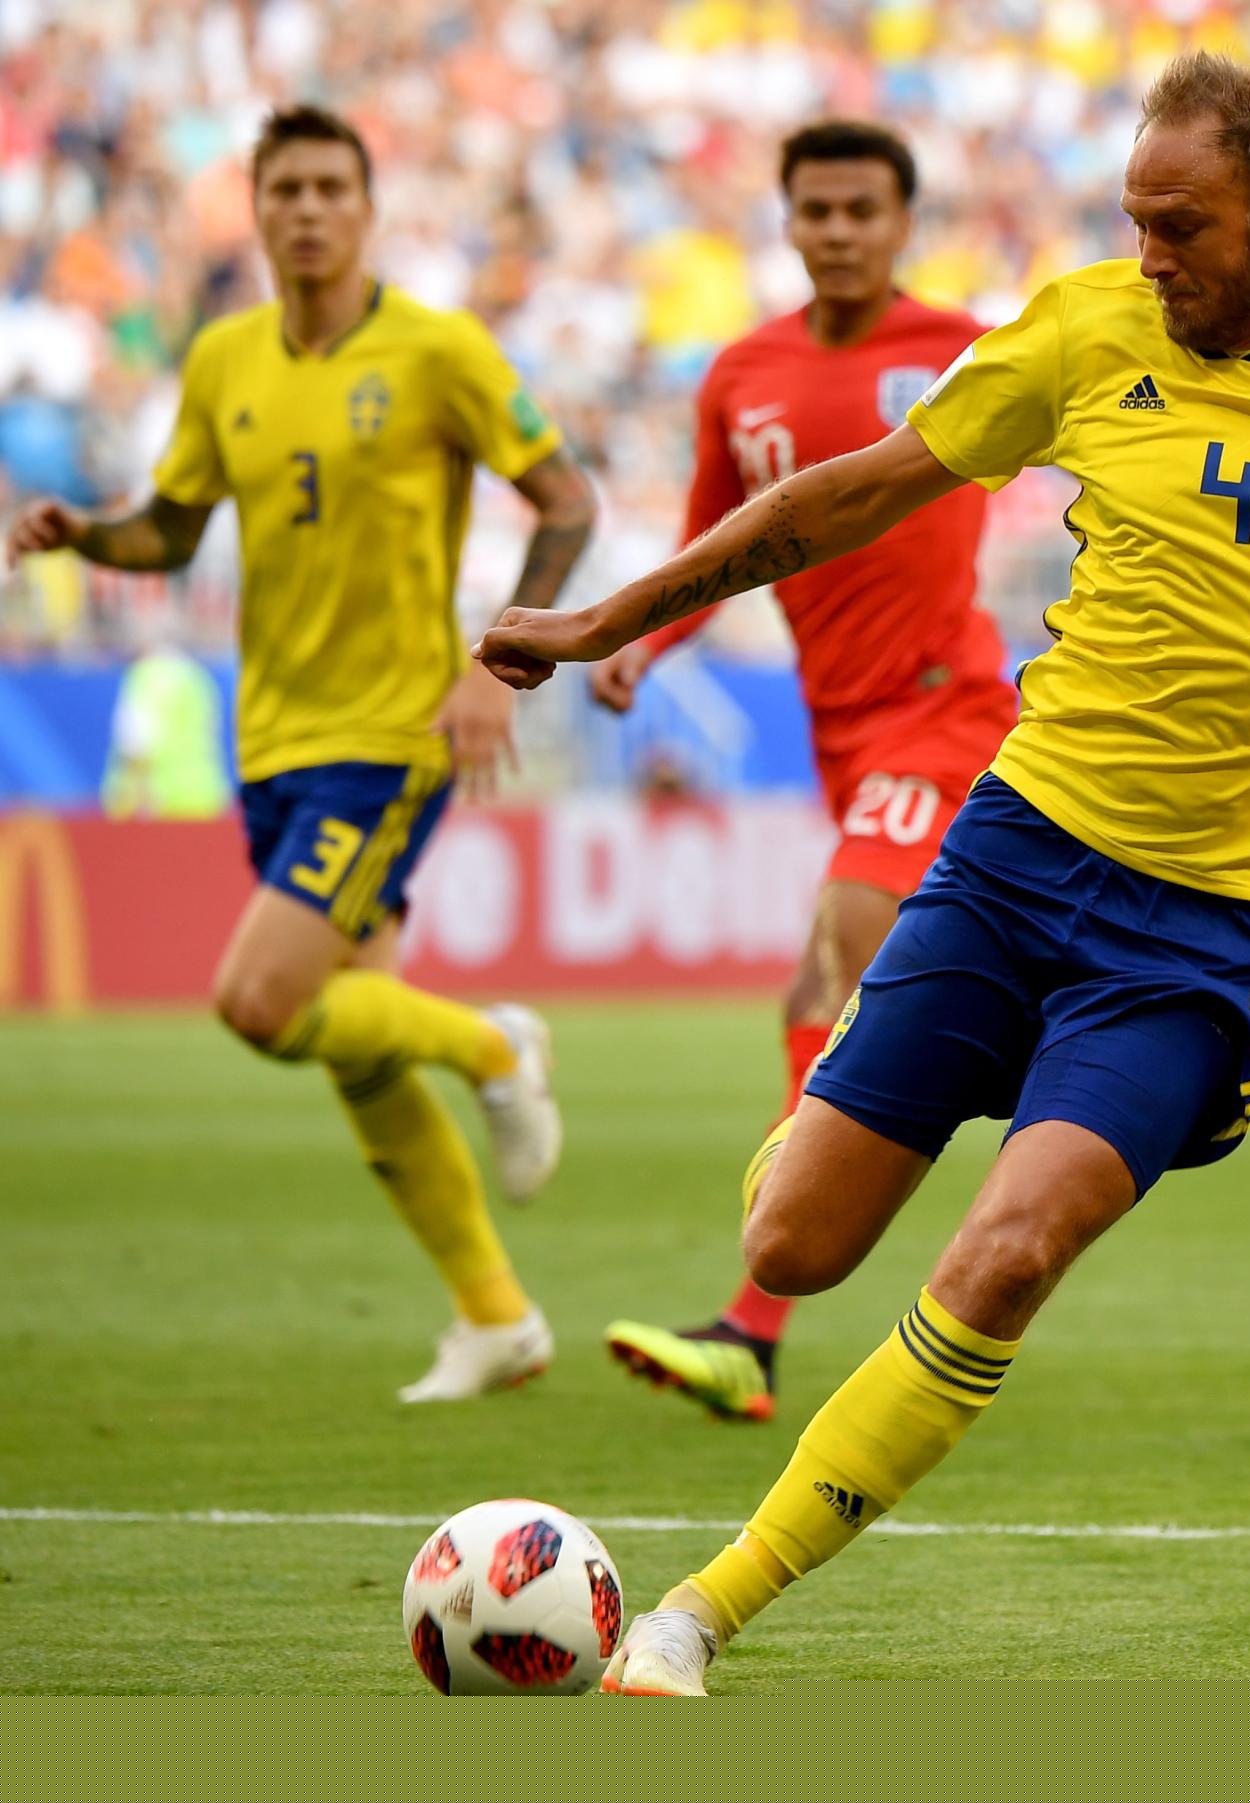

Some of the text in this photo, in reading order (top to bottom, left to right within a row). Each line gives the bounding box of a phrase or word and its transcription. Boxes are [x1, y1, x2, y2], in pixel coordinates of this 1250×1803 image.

[1119, 397, 1165, 410] adidas
[291, 452, 320, 527] 3
[844, 770, 941, 846] 20
[290, 817, 363, 898] 3
[813, 1481, 861, 1529] adidas
